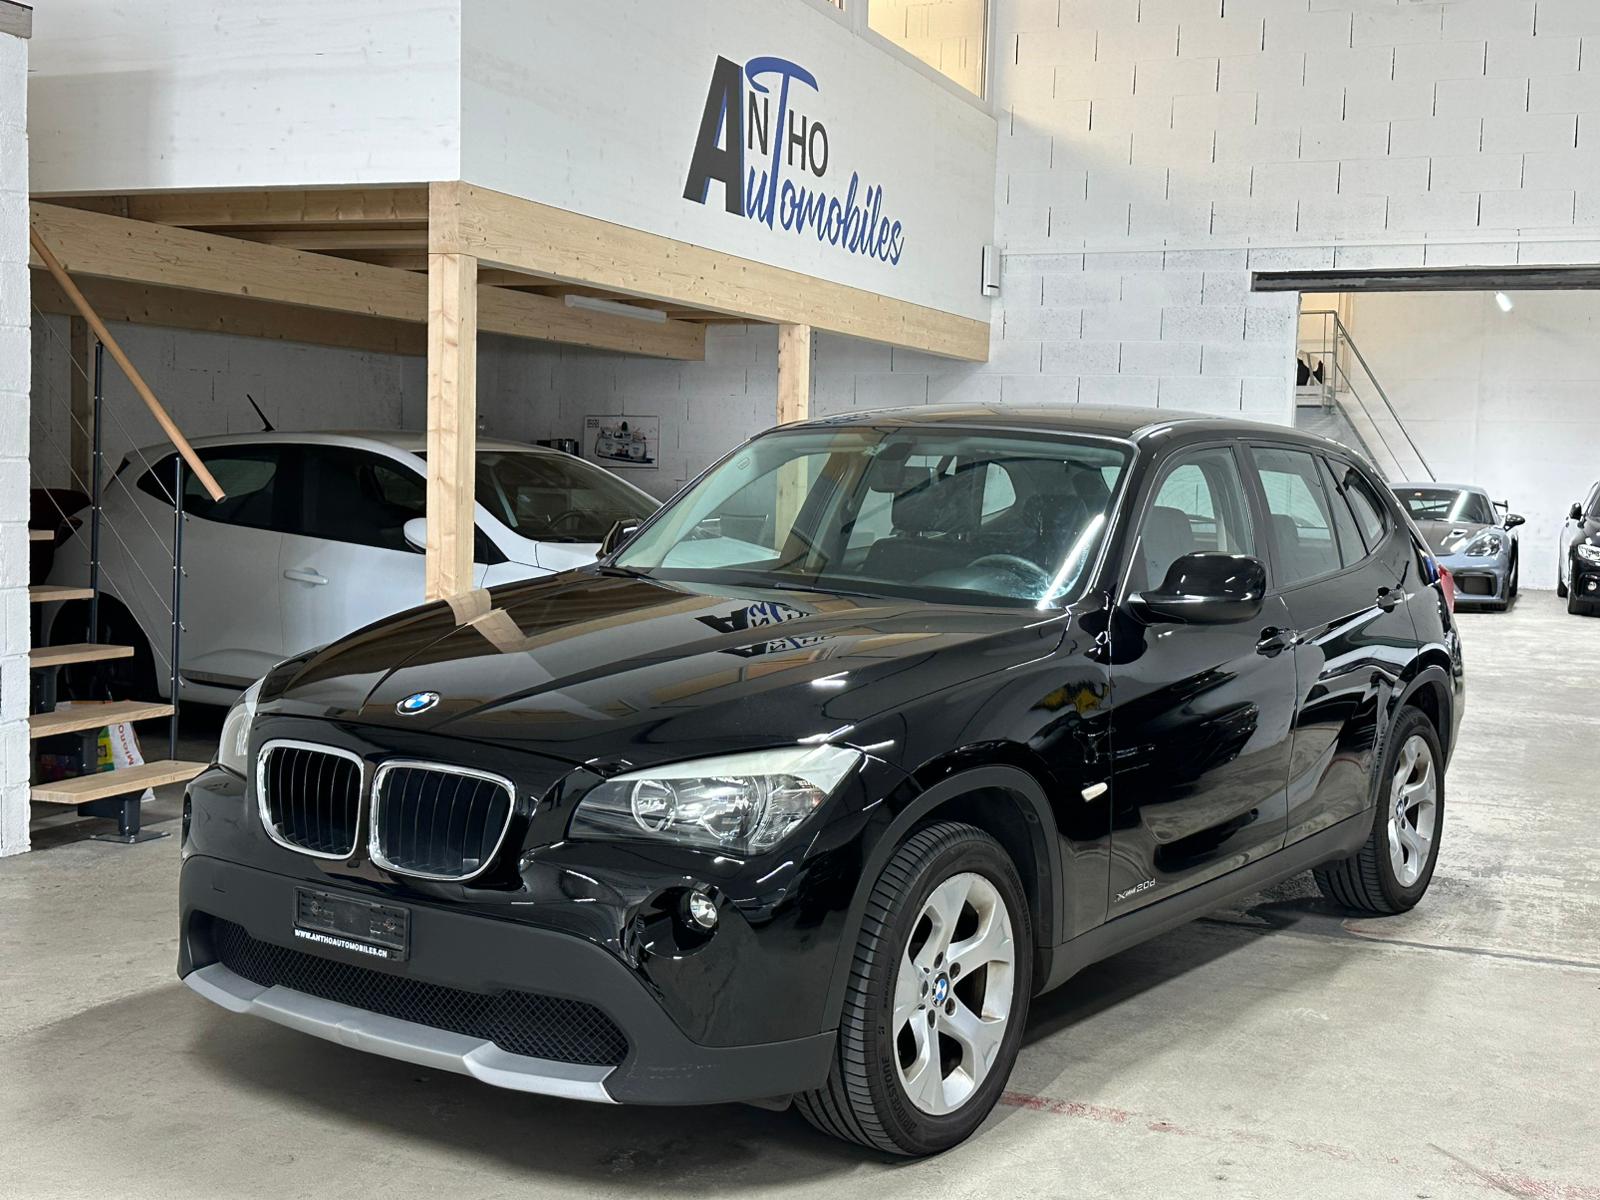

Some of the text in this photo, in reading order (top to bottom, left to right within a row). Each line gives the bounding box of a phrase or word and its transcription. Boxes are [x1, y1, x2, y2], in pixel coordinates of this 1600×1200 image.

[683, 55, 829, 230] ANTHO
[118, 724, 134, 766] MIGRO
[294, 929, 388, 959] WWW.ANTHOAUTOMOBILES.CH
